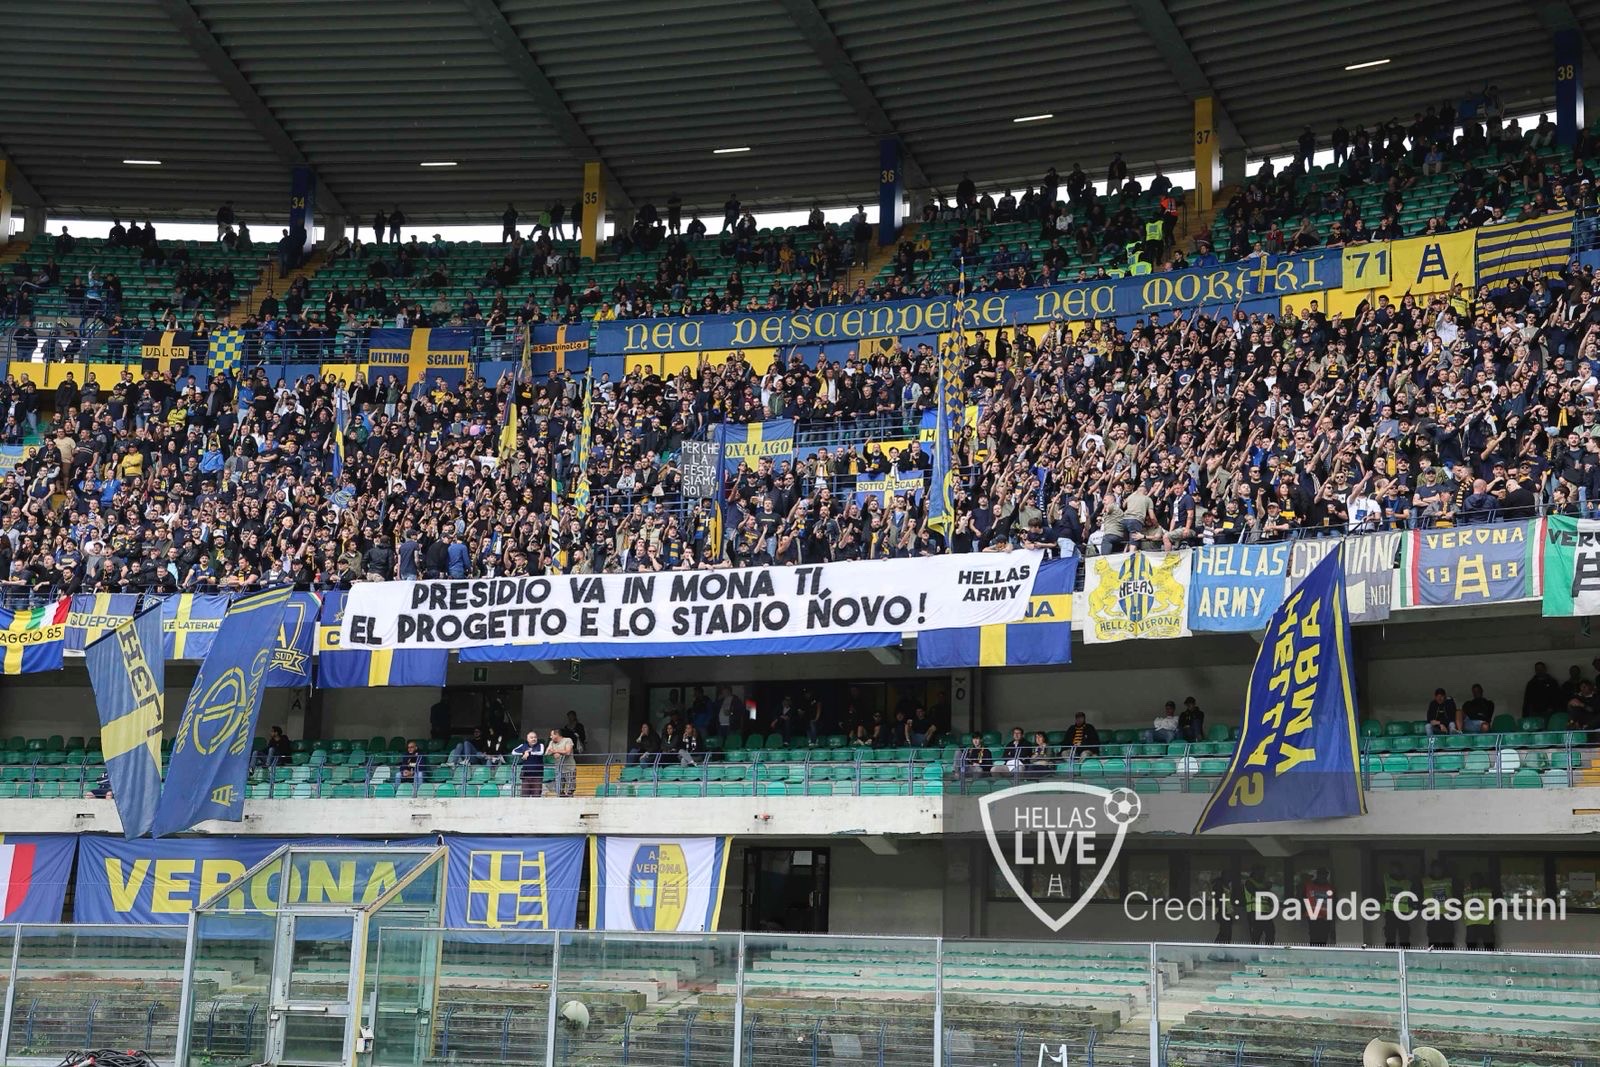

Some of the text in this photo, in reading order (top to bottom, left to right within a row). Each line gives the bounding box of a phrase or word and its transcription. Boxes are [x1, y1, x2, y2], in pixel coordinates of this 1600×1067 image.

[1558, 65, 1574, 80] 38
[1196, 130, 1210, 144] 37
[881, 169, 895, 183] 36
[292, 196, 305, 209] 34
[585, 191, 598, 204] 35
[371, 352, 465, 365] ULTIMO SCALIN
[692, 455, 709, 465] LA
[683, 464, 717, 476] FESTA
[858, 479, 922, 490] SOTTO SCALA
[1548, 528, 1600, 547] VER
[1197, 545, 1287, 577] HELLAS
[957, 565, 1031, 585] HELLAS
[411, 577, 551, 611] PRESIDIO
[569, 577, 606, 605] VA
[621, 575, 656, 604] IN
[669, 570, 775, 603] MONA
[961, 584, 1022, 602] ARMY
[1119, 579, 1154, 599] HELLAS
[1198, 586, 1265, 618] ARMY
[349, 615, 383, 646] EL
[397, 607, 568, 644] PROGETTO
[580, 606, 600, 637] E
[612, 606, 657, 638] LO
[671, 601, 791, 636] STADIO
[1099, 617, 1181, 634] HELLAS VERONA
[46, 627, 62, 639] 85
[637, 863, 682, 875] VERONA
[105, 857, 404, 917] VERONA
